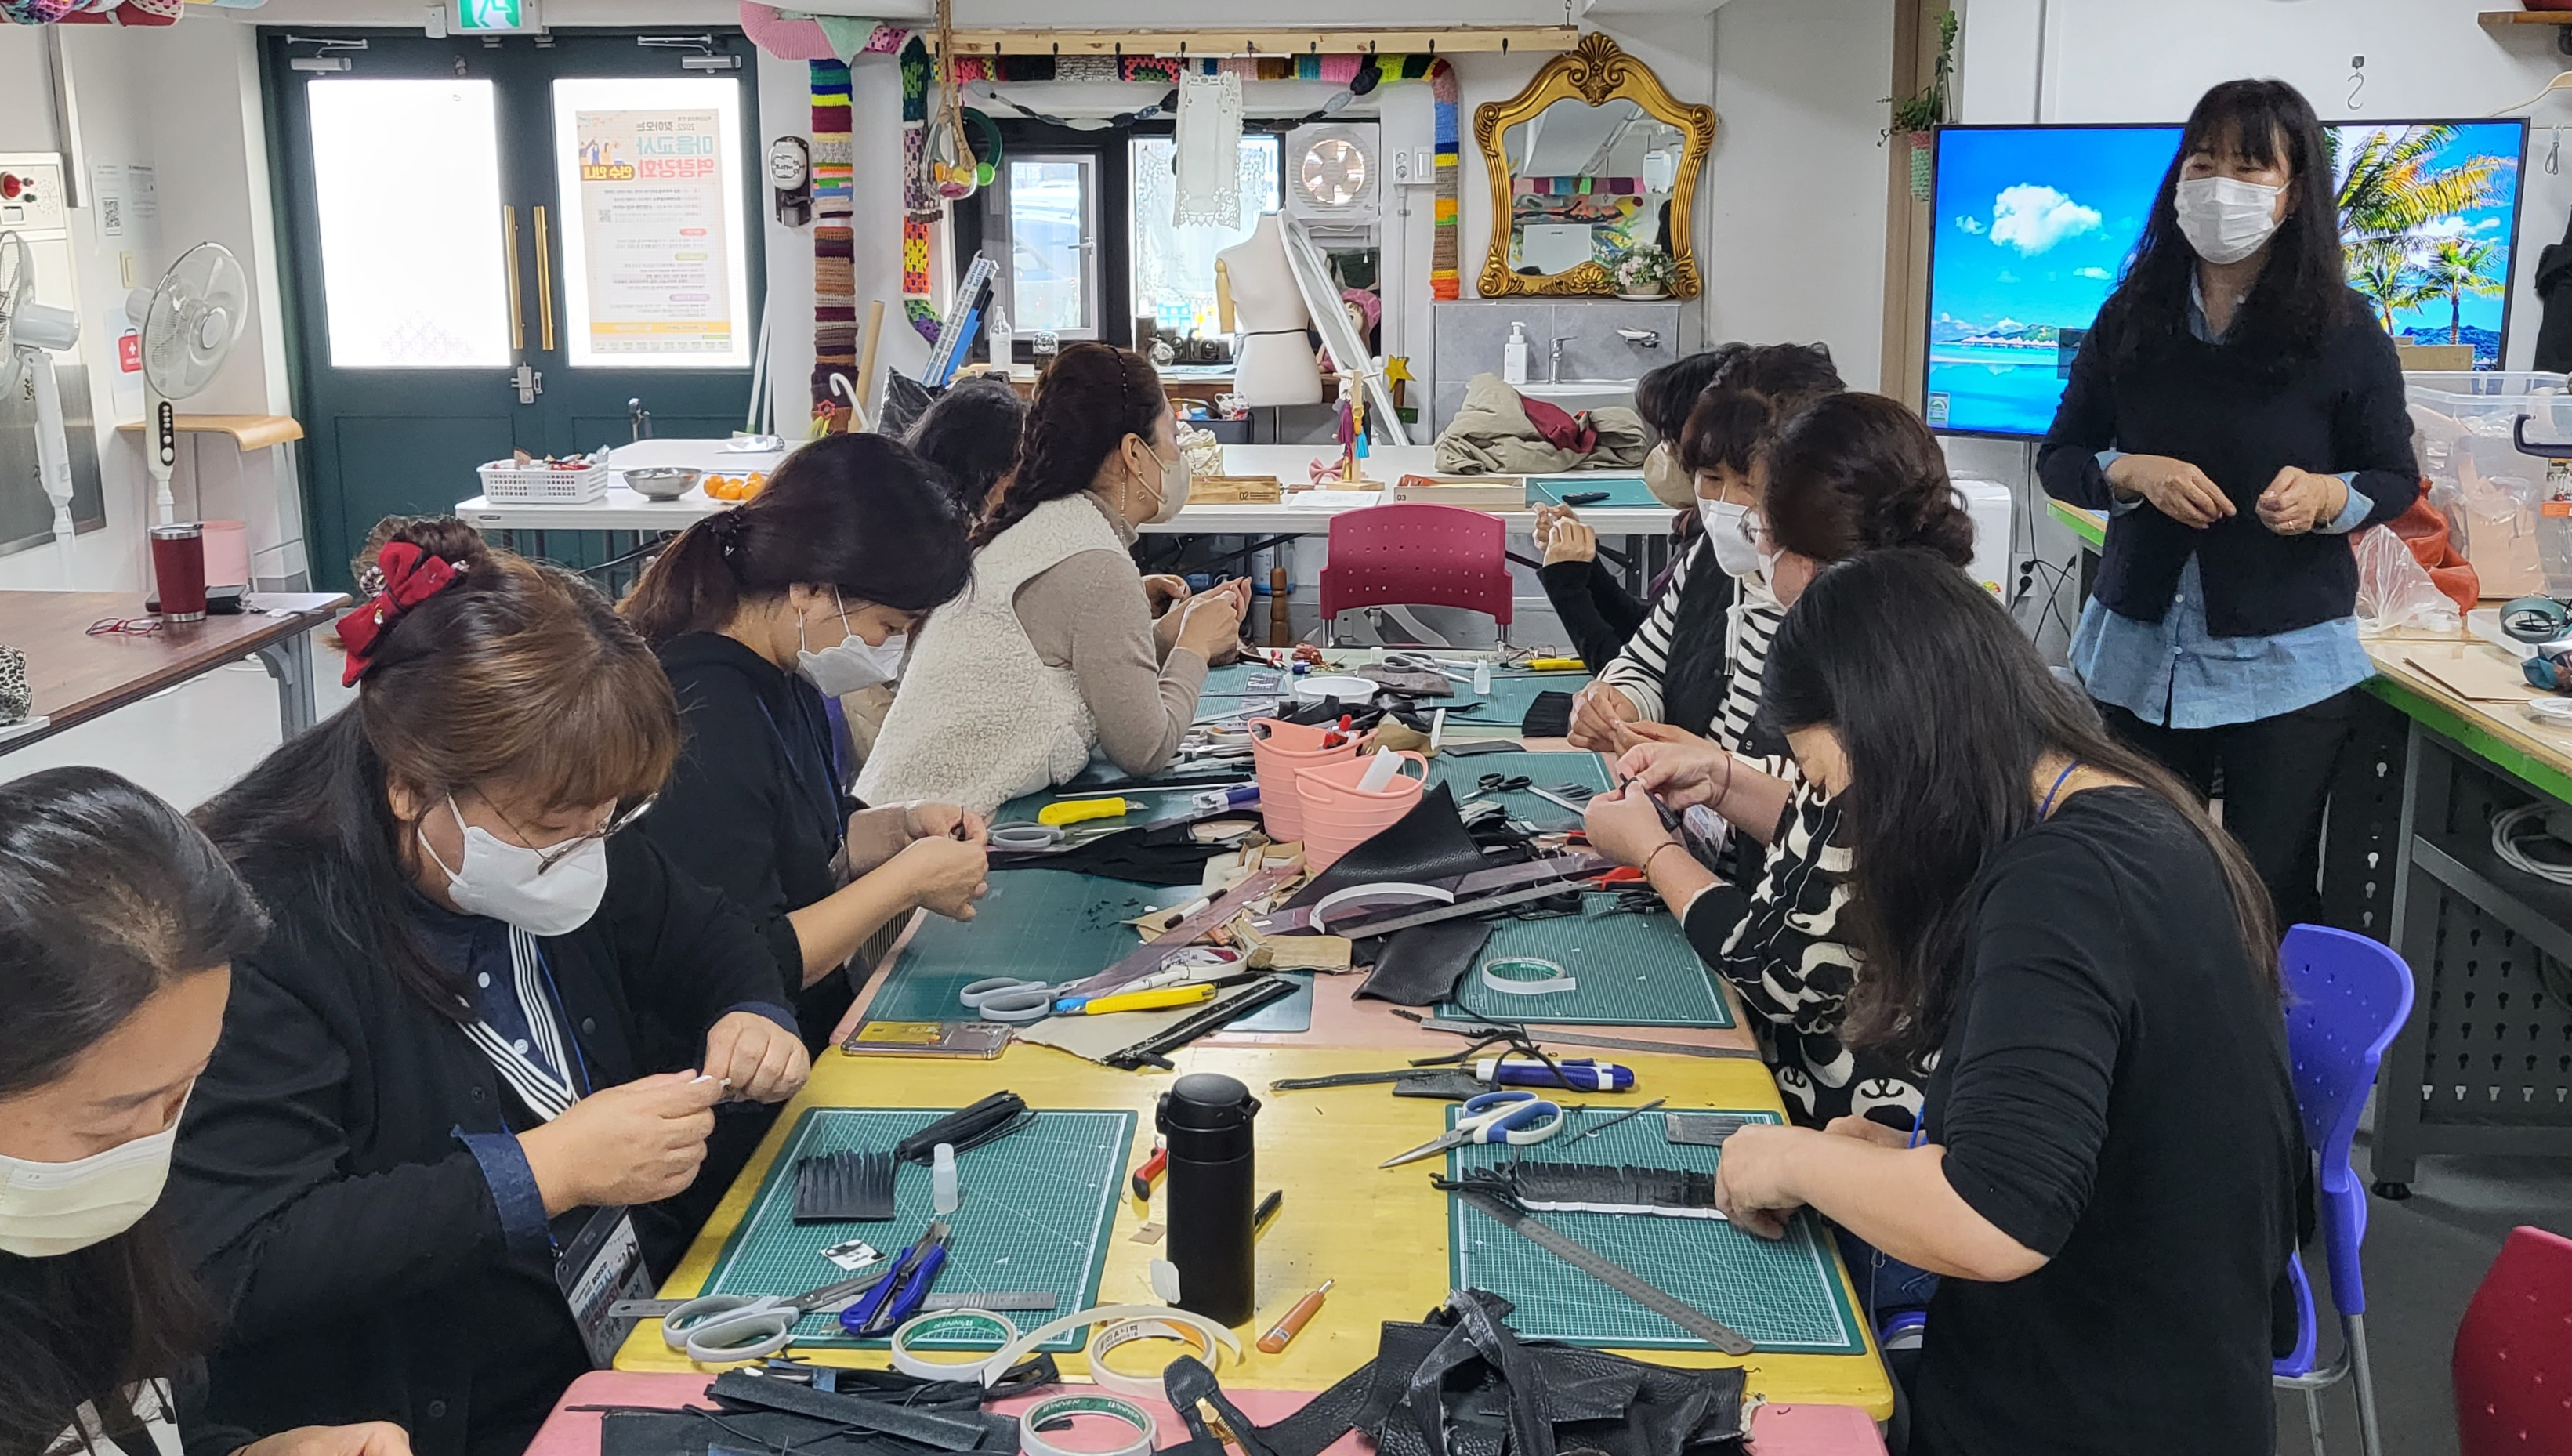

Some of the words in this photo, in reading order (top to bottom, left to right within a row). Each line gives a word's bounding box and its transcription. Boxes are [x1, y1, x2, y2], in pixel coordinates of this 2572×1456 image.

[973, 261, 987, 288] PHILIPS
[1239, 491, 1250, 501] 02
[933, 1320, 973, 1329] WINNER
[1107, 1400, 1140, 1419] WINNER
